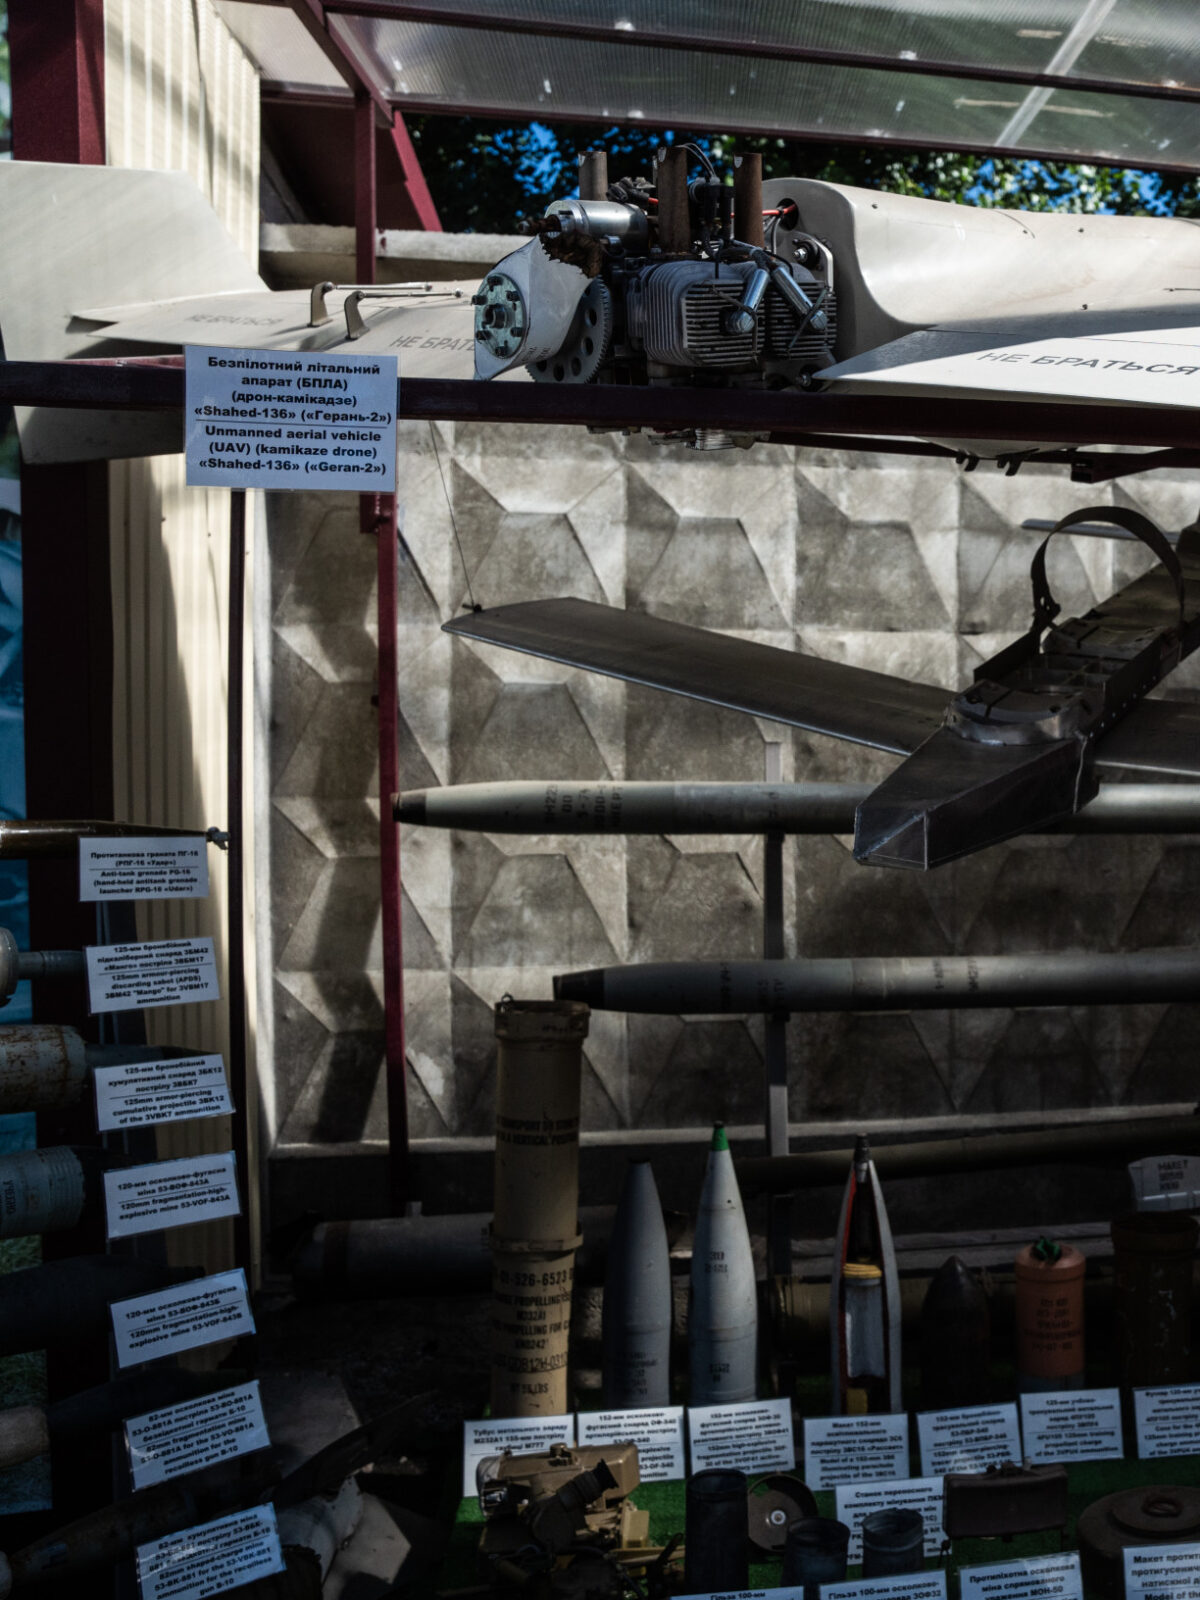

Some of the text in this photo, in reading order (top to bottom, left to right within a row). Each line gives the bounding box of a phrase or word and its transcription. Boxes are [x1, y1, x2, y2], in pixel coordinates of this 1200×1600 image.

[389, 336, 423, 348] НЕ
[208, 356, 380, 374] Безпілотний літальний
[976, 352, 1030, 362] НЕ
[241, 376, 347, 392] апарат (БПЛА)
[231, 390, 356, 408] (дрон-камікадзе)
[194, 405, 391, 424] «Shahed-136» («Герань-2»)
[205, 424, 381, 441] Unmanned aerial vehicle
[208, 441, 376, 458] (UAV) (kamikaze drone)
[198, 458, 386, 475] «Shahed-136» («Geran-2»)
